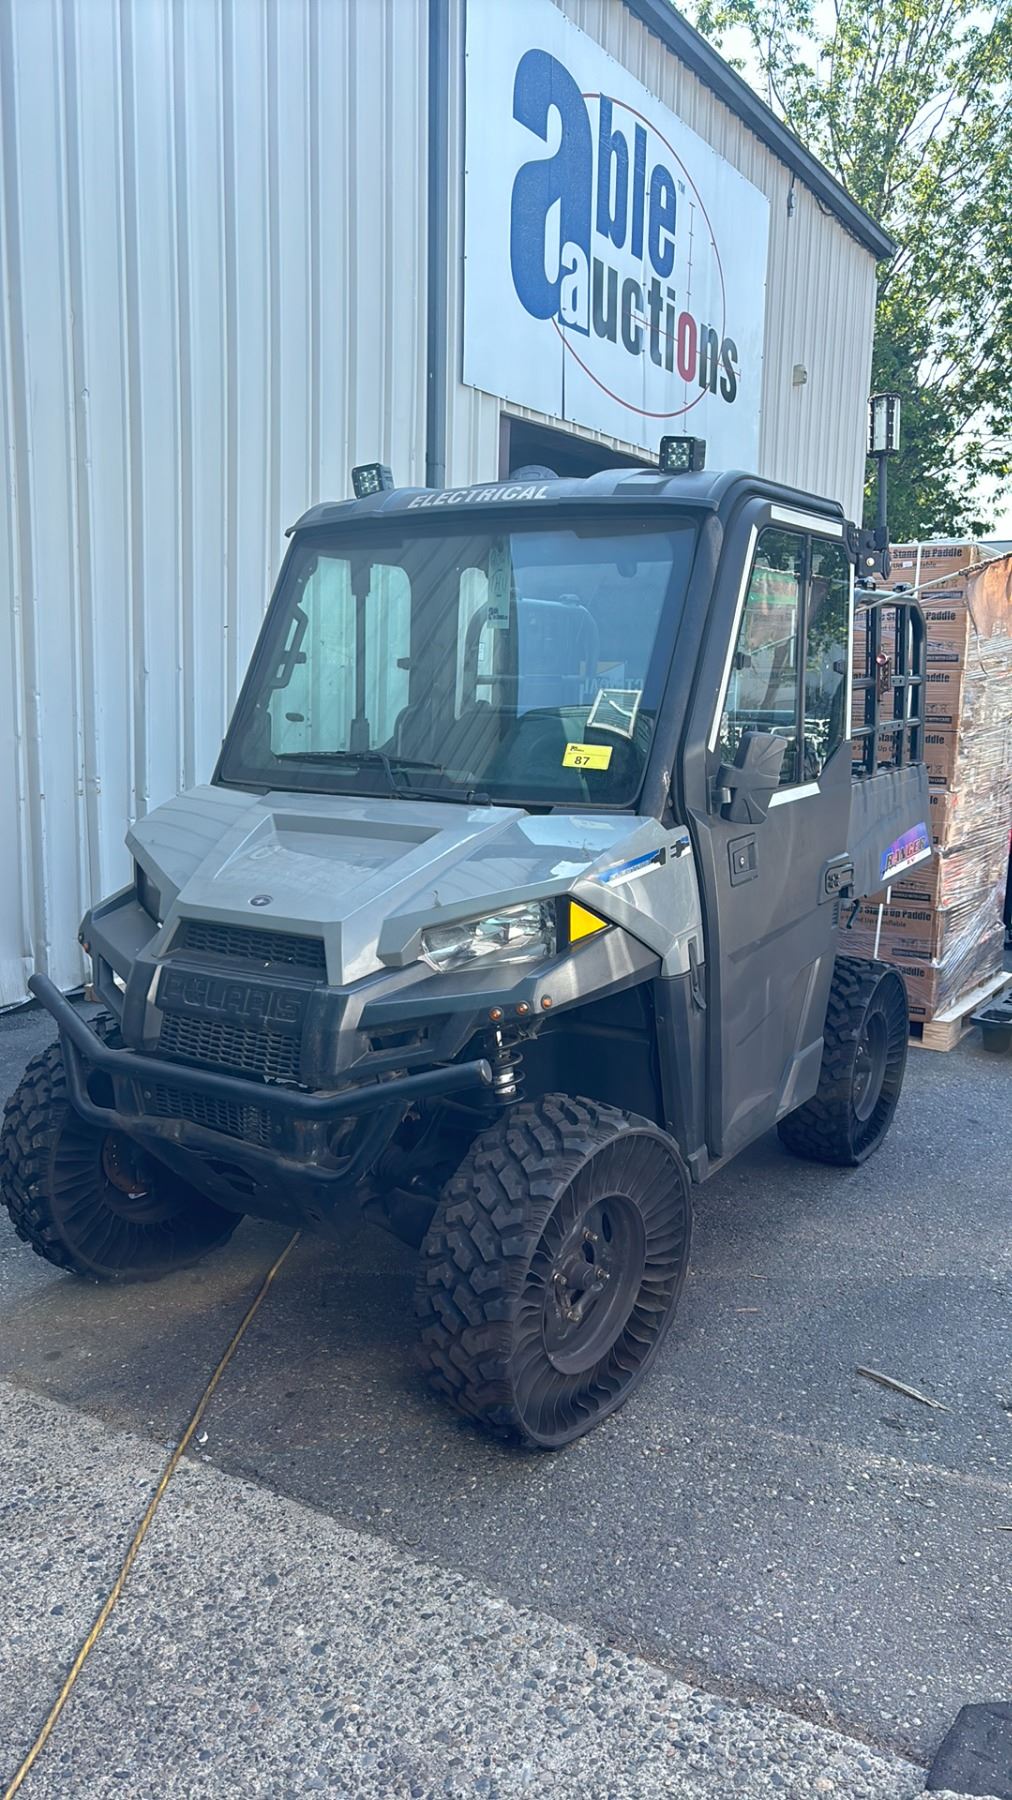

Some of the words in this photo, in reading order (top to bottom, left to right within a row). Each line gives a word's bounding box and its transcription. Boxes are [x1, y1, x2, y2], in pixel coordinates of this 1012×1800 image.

[558, 241, 739, 403] auctions
[407, 485, 549, 509] ELECTRICAL
[932, 548, 962, 557] Paddle
[926, 610, 956, 620] Paddle
[925, 735, 945, 745] ddle
[574, 756, 590, 766] 87
[902, 912, 931, 920] Paddle
[161, 971, 301, 1023] POLARIS
